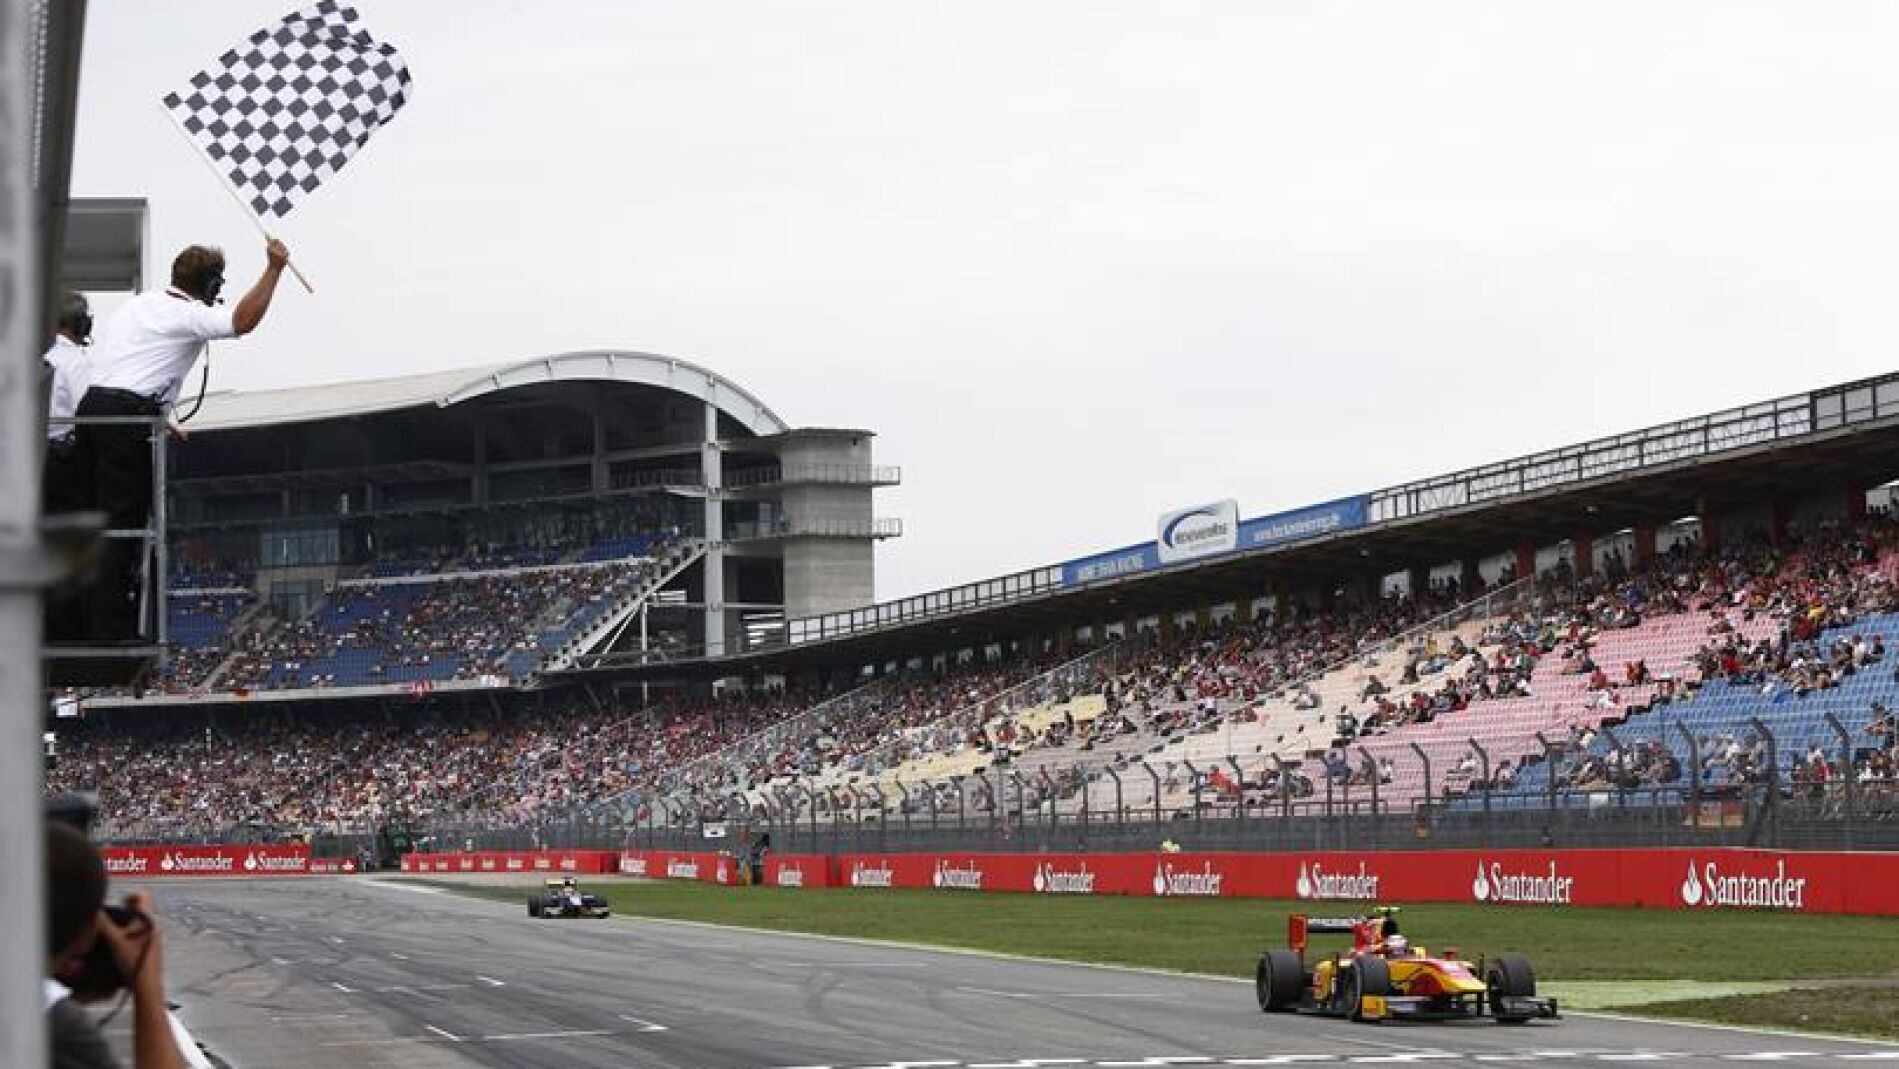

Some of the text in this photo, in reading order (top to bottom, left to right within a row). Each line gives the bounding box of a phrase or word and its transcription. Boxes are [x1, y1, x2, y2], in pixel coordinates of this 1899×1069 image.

[104, 851, 147, 871] tander
[175, 851, 233, 870] Santander
[1045, 863, 1095, 893] Santander
[1166, 863, 1222, 895] Santander
[1312, 863, 1378, 898] Santander
[1490, 861, 1573, 903] Santander
[1704, 860, 1805, 907] Santander
